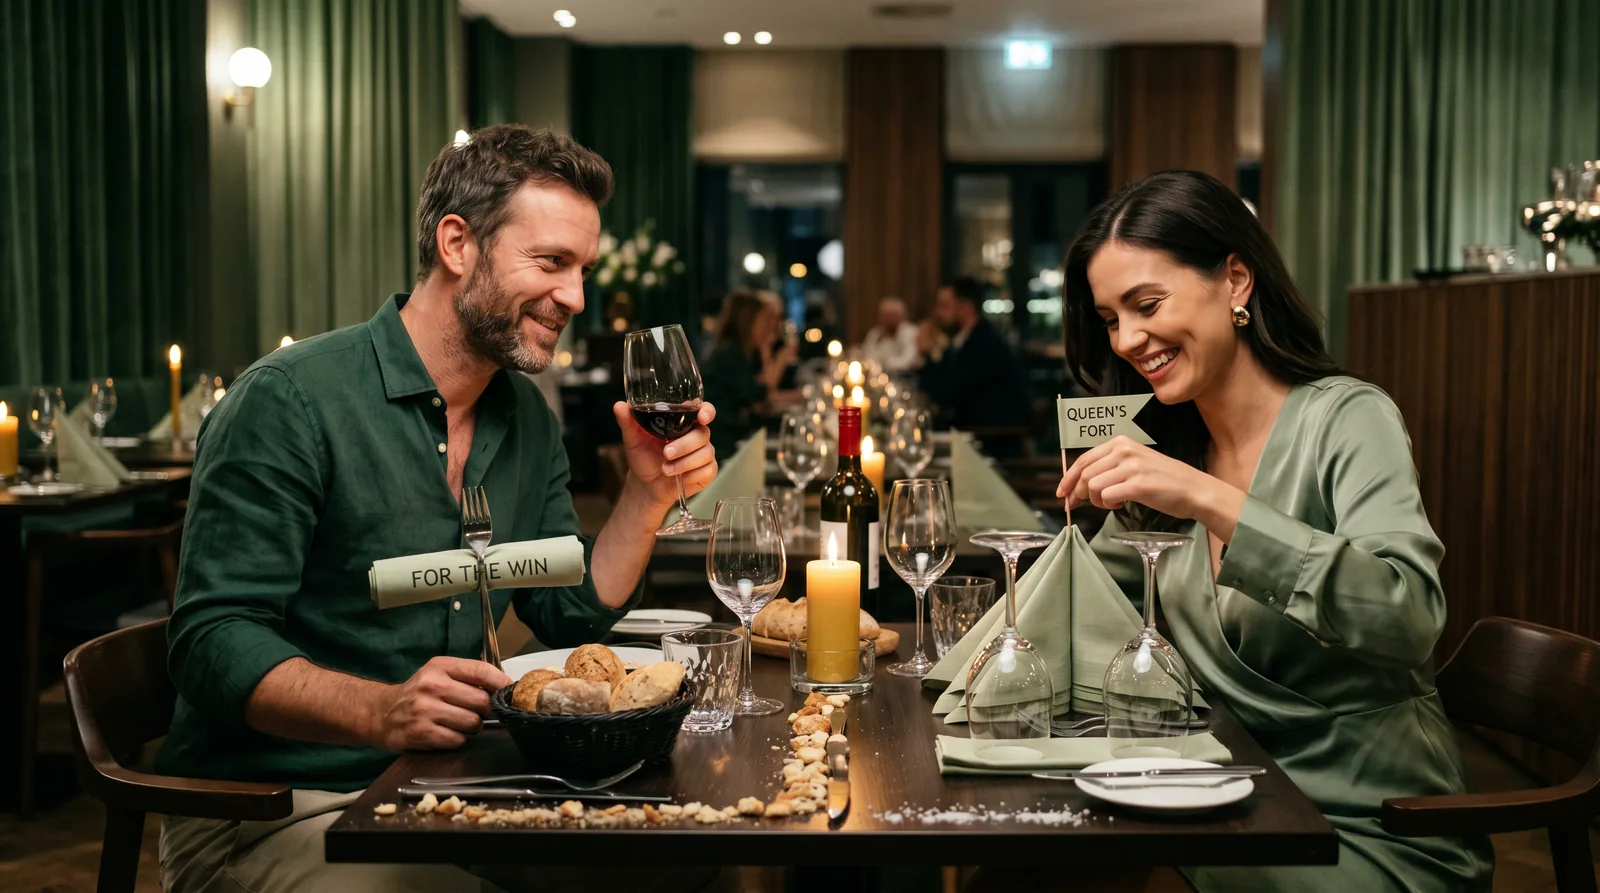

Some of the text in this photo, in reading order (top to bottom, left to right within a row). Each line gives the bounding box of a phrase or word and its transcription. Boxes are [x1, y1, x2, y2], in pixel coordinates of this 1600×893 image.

[1067, 405, 1127, 421] QUEEN'S
[1079, 424, 1115, 437] FORT
[411, 557, 548, 588] FOR THE WIN
